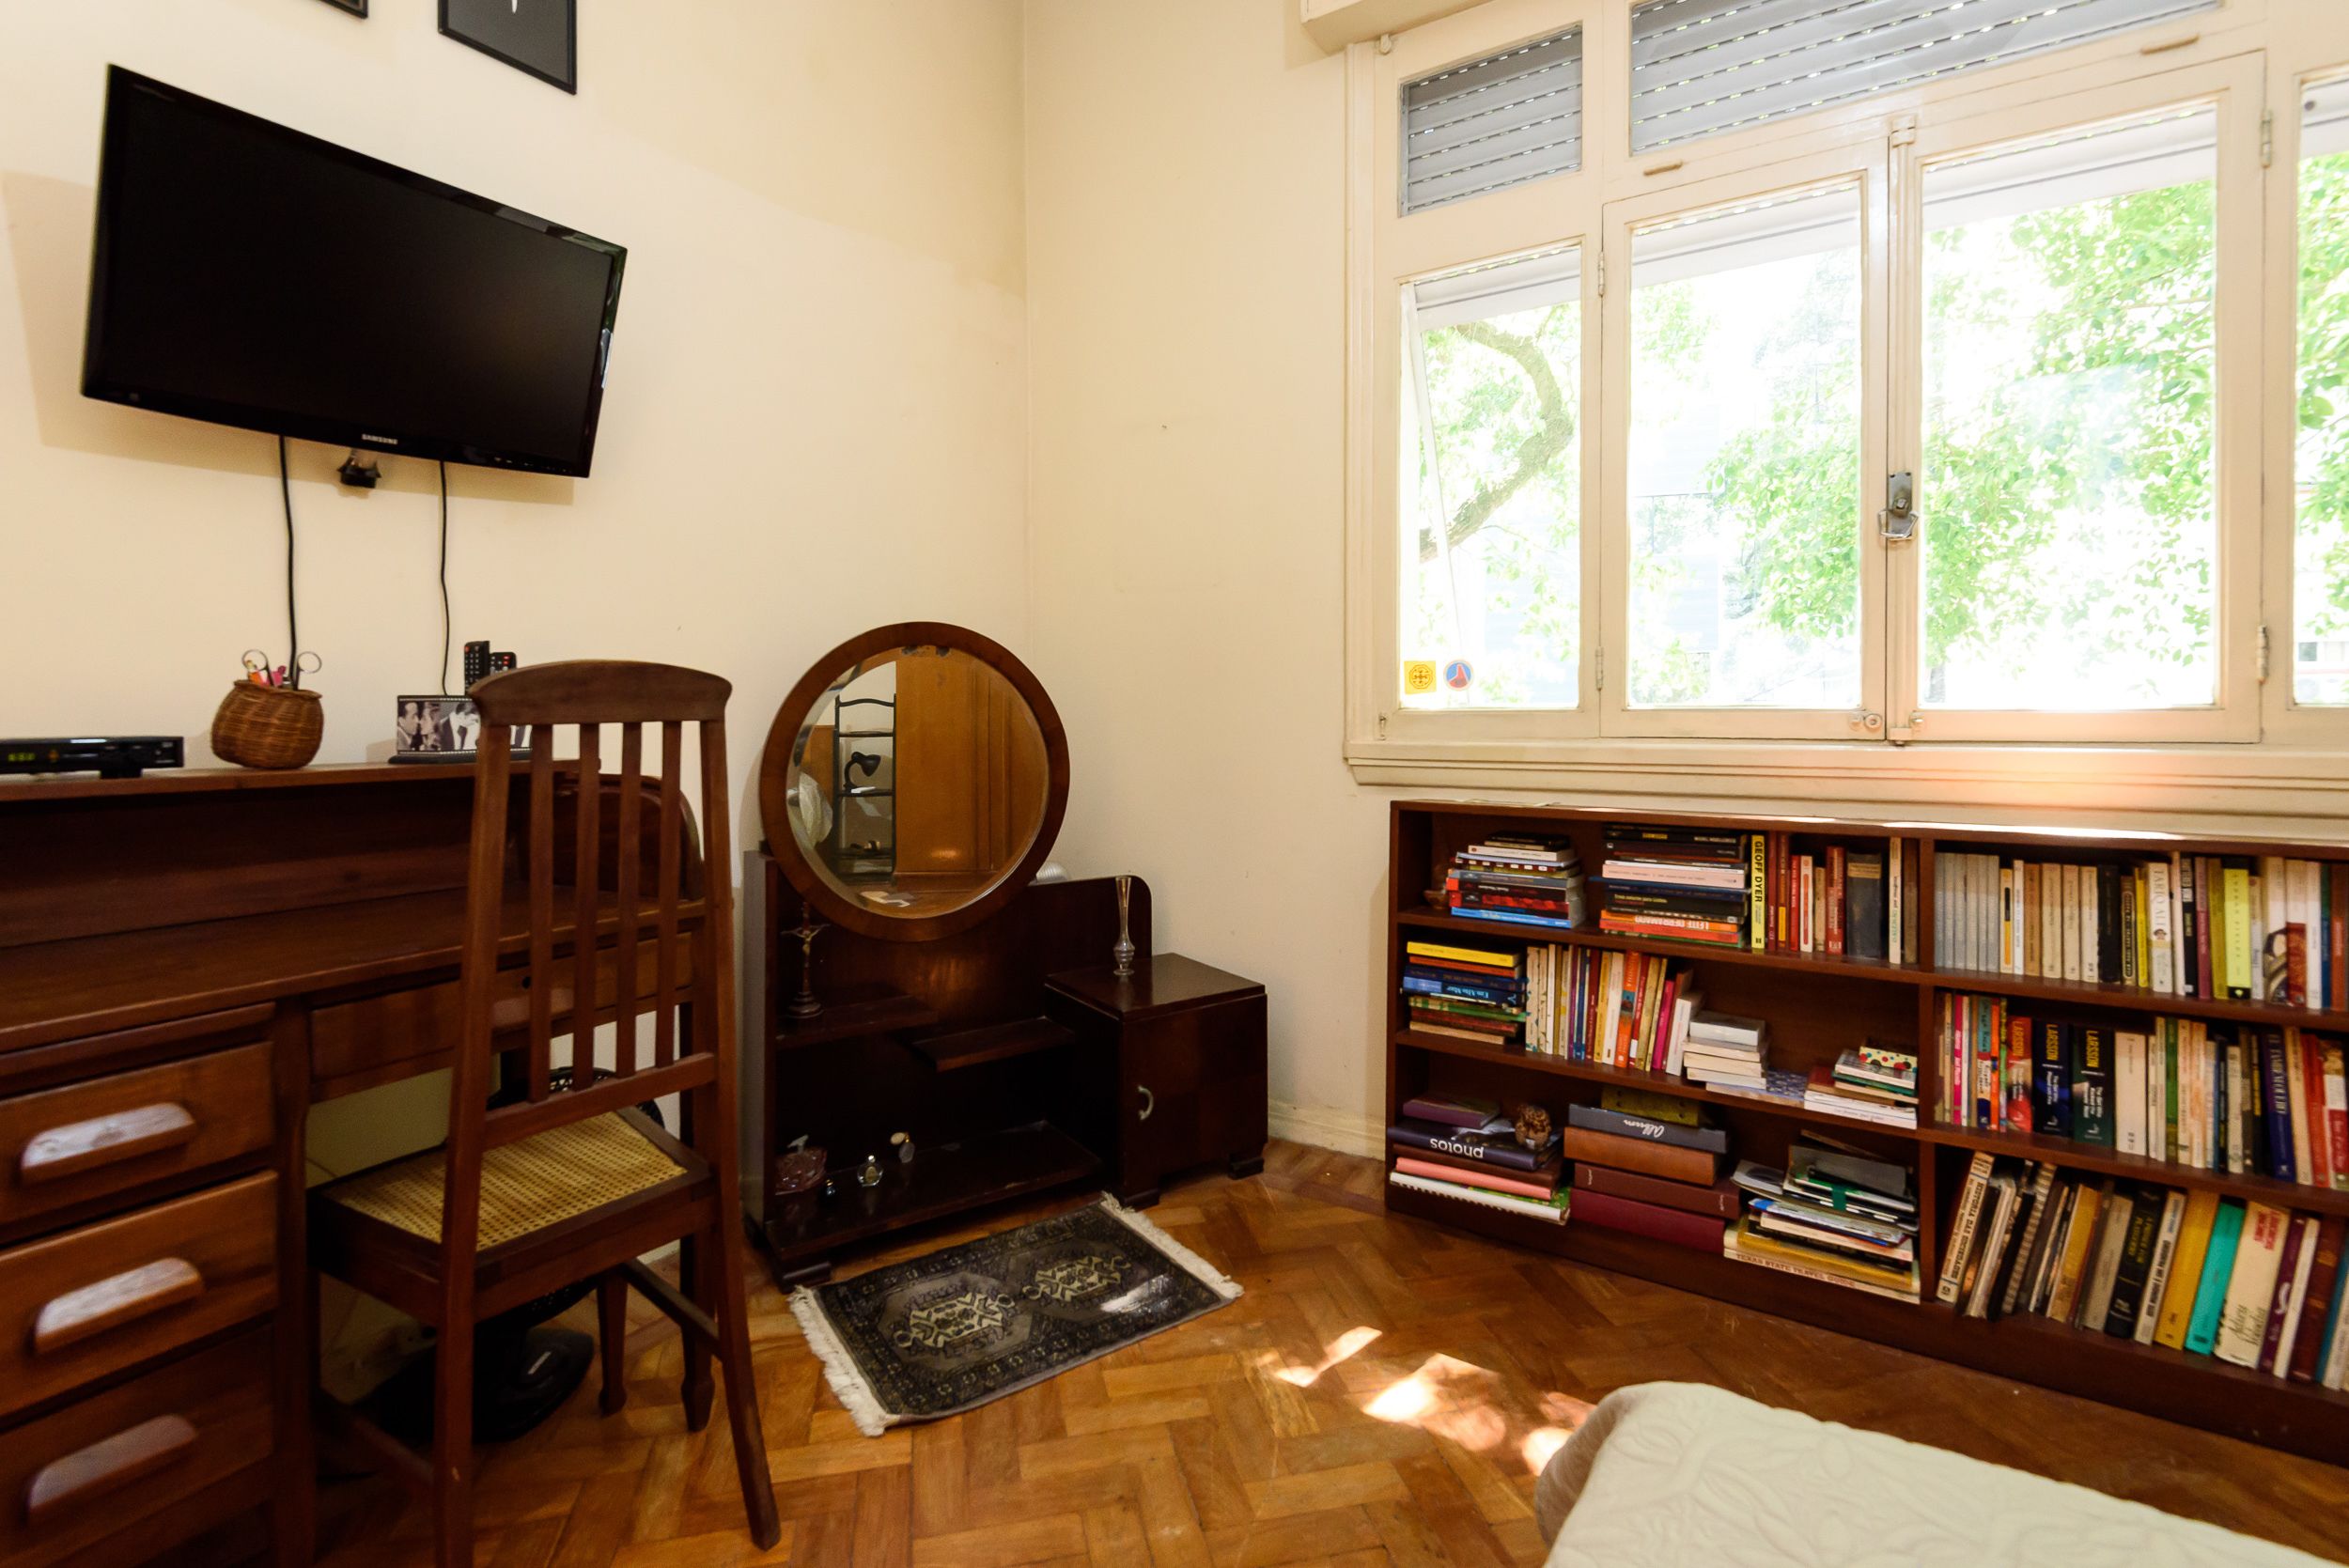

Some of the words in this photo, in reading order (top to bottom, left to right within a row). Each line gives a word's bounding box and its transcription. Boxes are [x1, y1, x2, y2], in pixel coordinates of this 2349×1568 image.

[1754, 841, 1764, 873] GEOFF
[1754, 876, 1764, 903] DYER
[2012, 1020, 2024, 1058] LARSSON
[2046, 1023, 2059, 1062] LARSSON
[2086, 1030, 2099, 1068] LARSSON
[1429, 1136, 1485, 1159] photos
